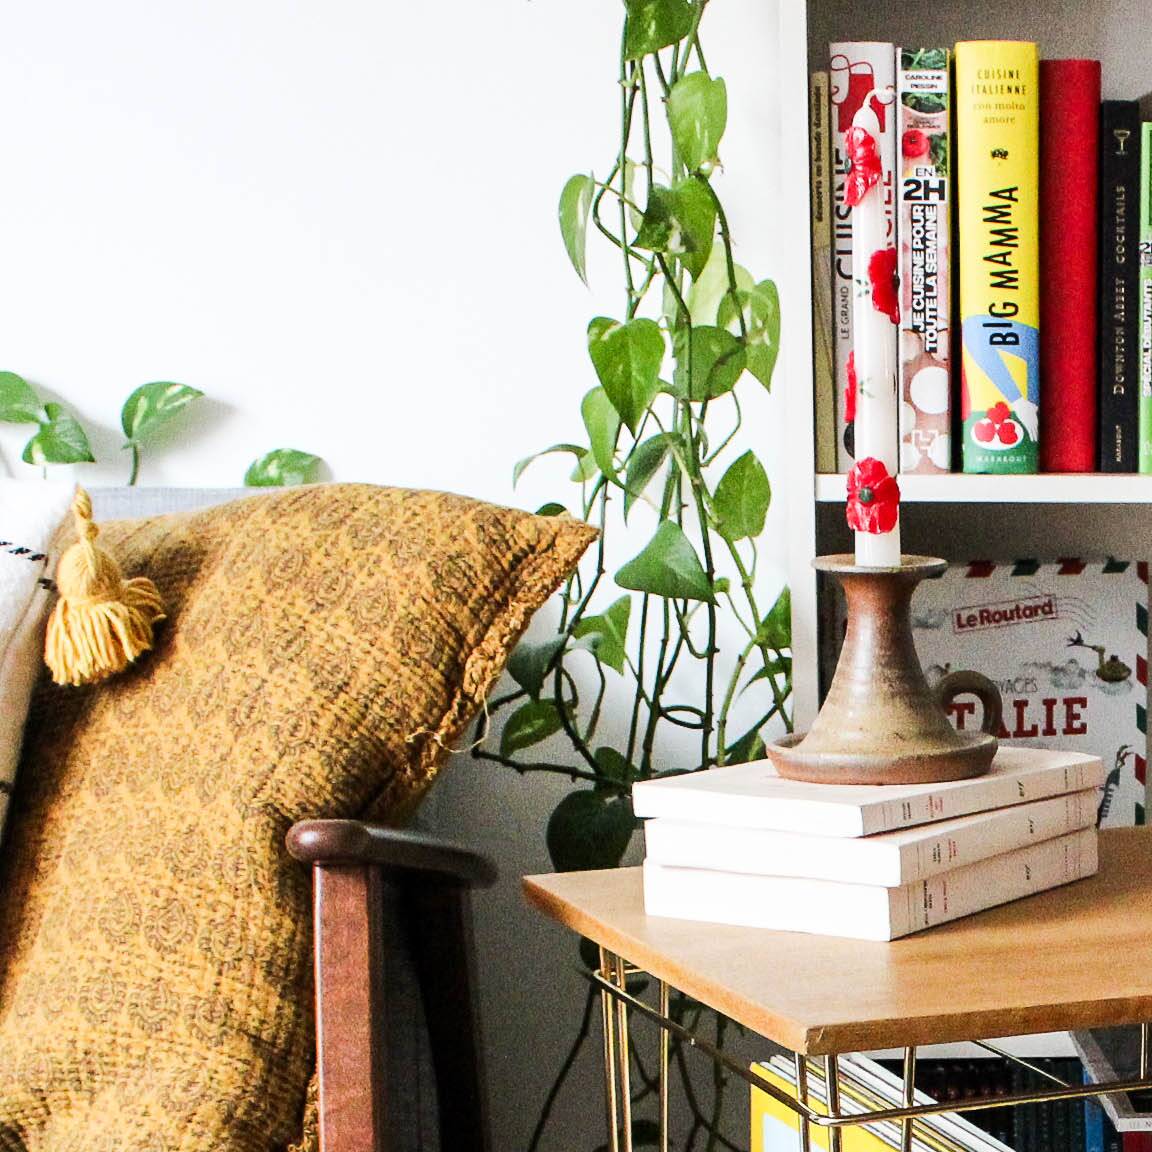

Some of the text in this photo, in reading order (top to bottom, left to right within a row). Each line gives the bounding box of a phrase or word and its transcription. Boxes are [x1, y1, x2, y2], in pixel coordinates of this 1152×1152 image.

[971, 85, 1027, 96] ITALIENNE
[977, 69, 1021, 80] CUISINE
[903, 179, 946, 201] 2H
[915, 168, 933, 177] EN
[1115, 184, 1126, 264] COCKTAILS
[912, 205, 924, 332] JE CUISINE POUR
[925, 205, 937, 351] TOUTE LA SEMAINE
[982, 186, 1019, 346] BIG MAMMA
[840, 286, 849, 325] GRAND
[1112, 326, 1125, 395] DOWNTON
[955, 600, 1053, 629] Le Routard
